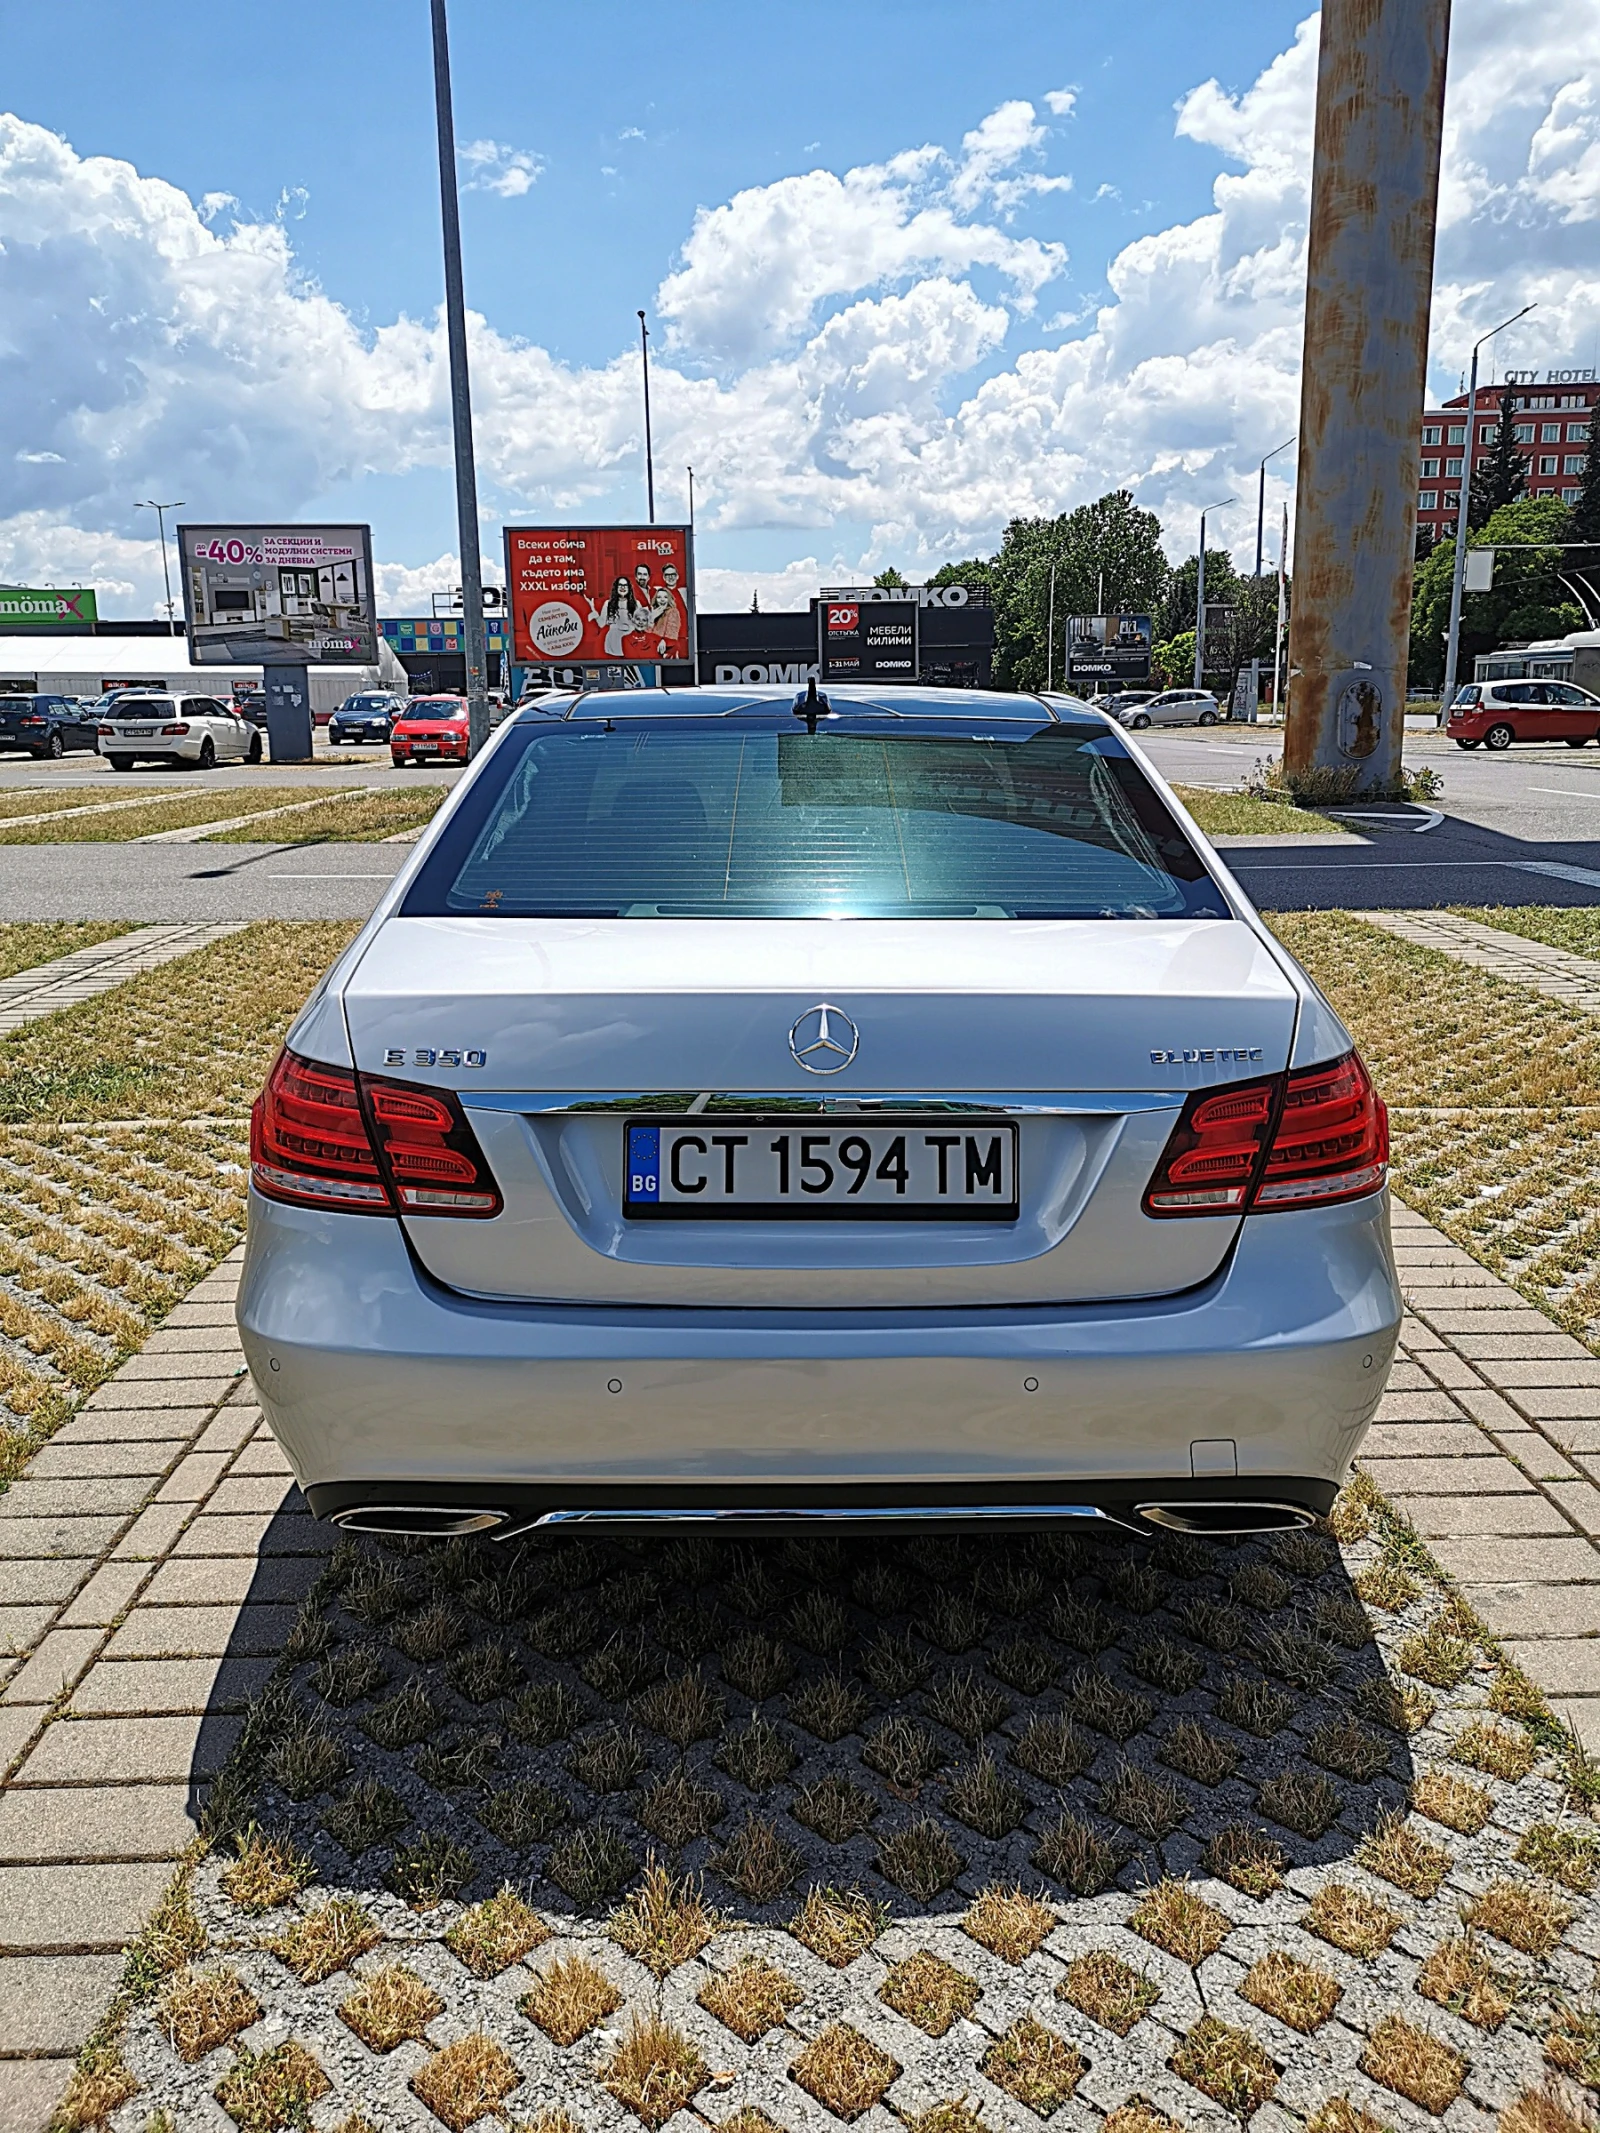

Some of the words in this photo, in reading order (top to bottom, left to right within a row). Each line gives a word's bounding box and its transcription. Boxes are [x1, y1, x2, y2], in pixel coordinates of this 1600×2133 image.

[1504, 370, 1539, 383] CITY
[1547, 368, 1600, 383] HOTEL
[277, 538, 313, 546] СЕКЦИИ
[518, 539, 550, 549] Всеки
[552, 539, 585, 549] обича
[637, 539, 672, 550] aiko
[196, 540, 263, 564] -40%
[265, 547, 309, 555] МОДУЛНИ
[311, 547, 352, 555] СИСТЕМИ
[529, 555, 542, 564] да
[545, 555, 551, 563] е
[553, 555, 576, 564] там,
[522, 569, 561, 578] където
[520, 581, 548, 590] XXXL
[551, 580, 587, 592] избор!
[829, 609, 858, 623] 20%
[537, 618, 578, 640] Айкови
[870, 626, 911, 635] МЕБЕЛИ
[867, 636, 911, 645] КИЛИМИ
[843, 659, 860, 667] МАЙ
[1073, 664, 1111, 672] DOMKO
[715, 664, 820, 683] DOMK
[383, 1048, 406, 1066] E
[412, 1048, 487, 1067] 350
[1150, 1047, 1263, 1064] BLUETEC
[670, 1135, 749, 1194] CT
[770, 1135, 909, 1194] 1594
[924, 1135, 1002, 1194] TM
[631, 1175, 656, 1192] BG
